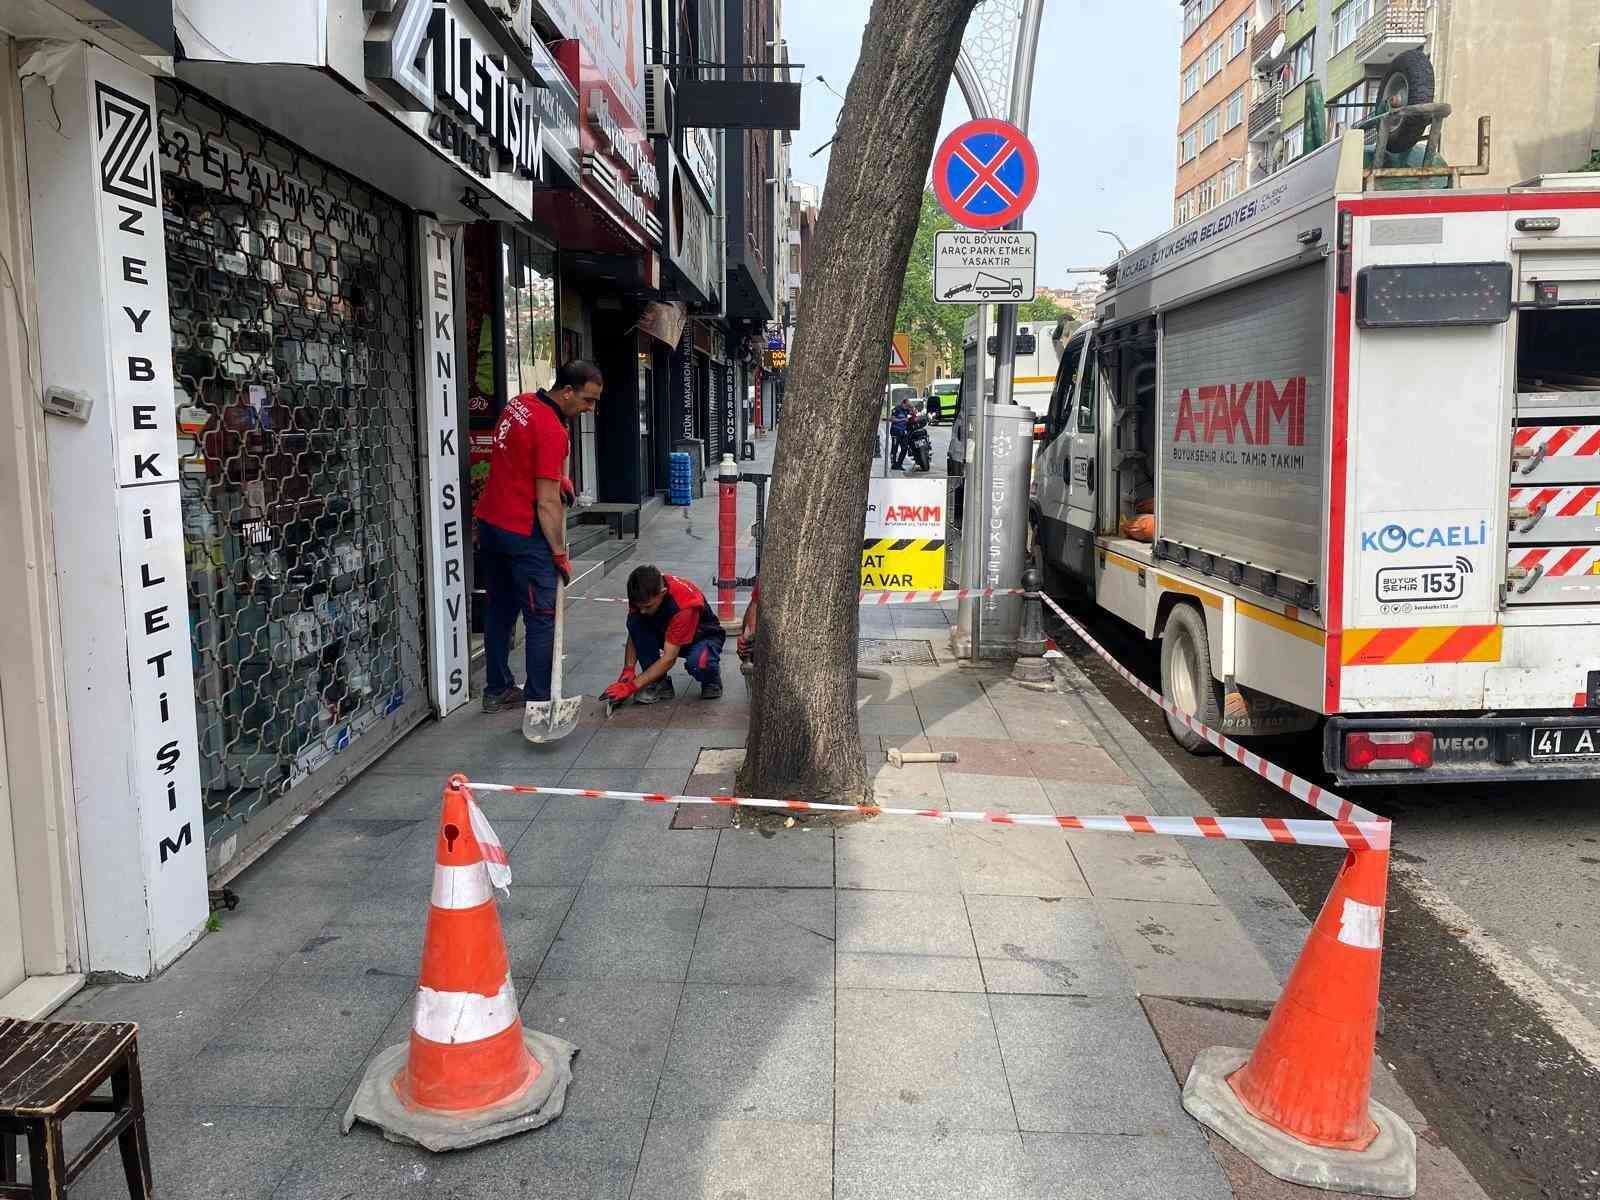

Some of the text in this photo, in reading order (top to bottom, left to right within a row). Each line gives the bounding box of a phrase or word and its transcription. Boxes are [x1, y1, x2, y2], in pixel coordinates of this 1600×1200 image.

[1199, 198, 1258, 241] BELEDİYESİ
[941, 247, 1031, 256] ARAÇ PARK ETMEK
[953, 236, 1020, 245] YOL BOYUNCA
[117, 204, 163, 479] ZEYBEK
[427, 231, 457, 457] TEKNİK
[683, 362, 692, 408] MAKARON
[725, 358, 736, 443] BARBERSHOP
[1173, 375, 1306, 446] A-TAKIMI
[1241, 452, 1267, 467] TAMİR
[1271, 454, 1304, 470] TAKIMI
[1361, 519, 1486, 553] KOCAELİ
[441, 483, 464, 697] SERVİS
[880, 574, 913, 587] VAR
[1383, 572, 1456, 593] BÜYÜK 153
[1383, 585, 1418, 593] ŞEHİR
[141, 508, 193, 864] İLETİŞİM
[1433, 737, 1489, 751] IVECO
[1537, 728, 1600, 753] 41 A
